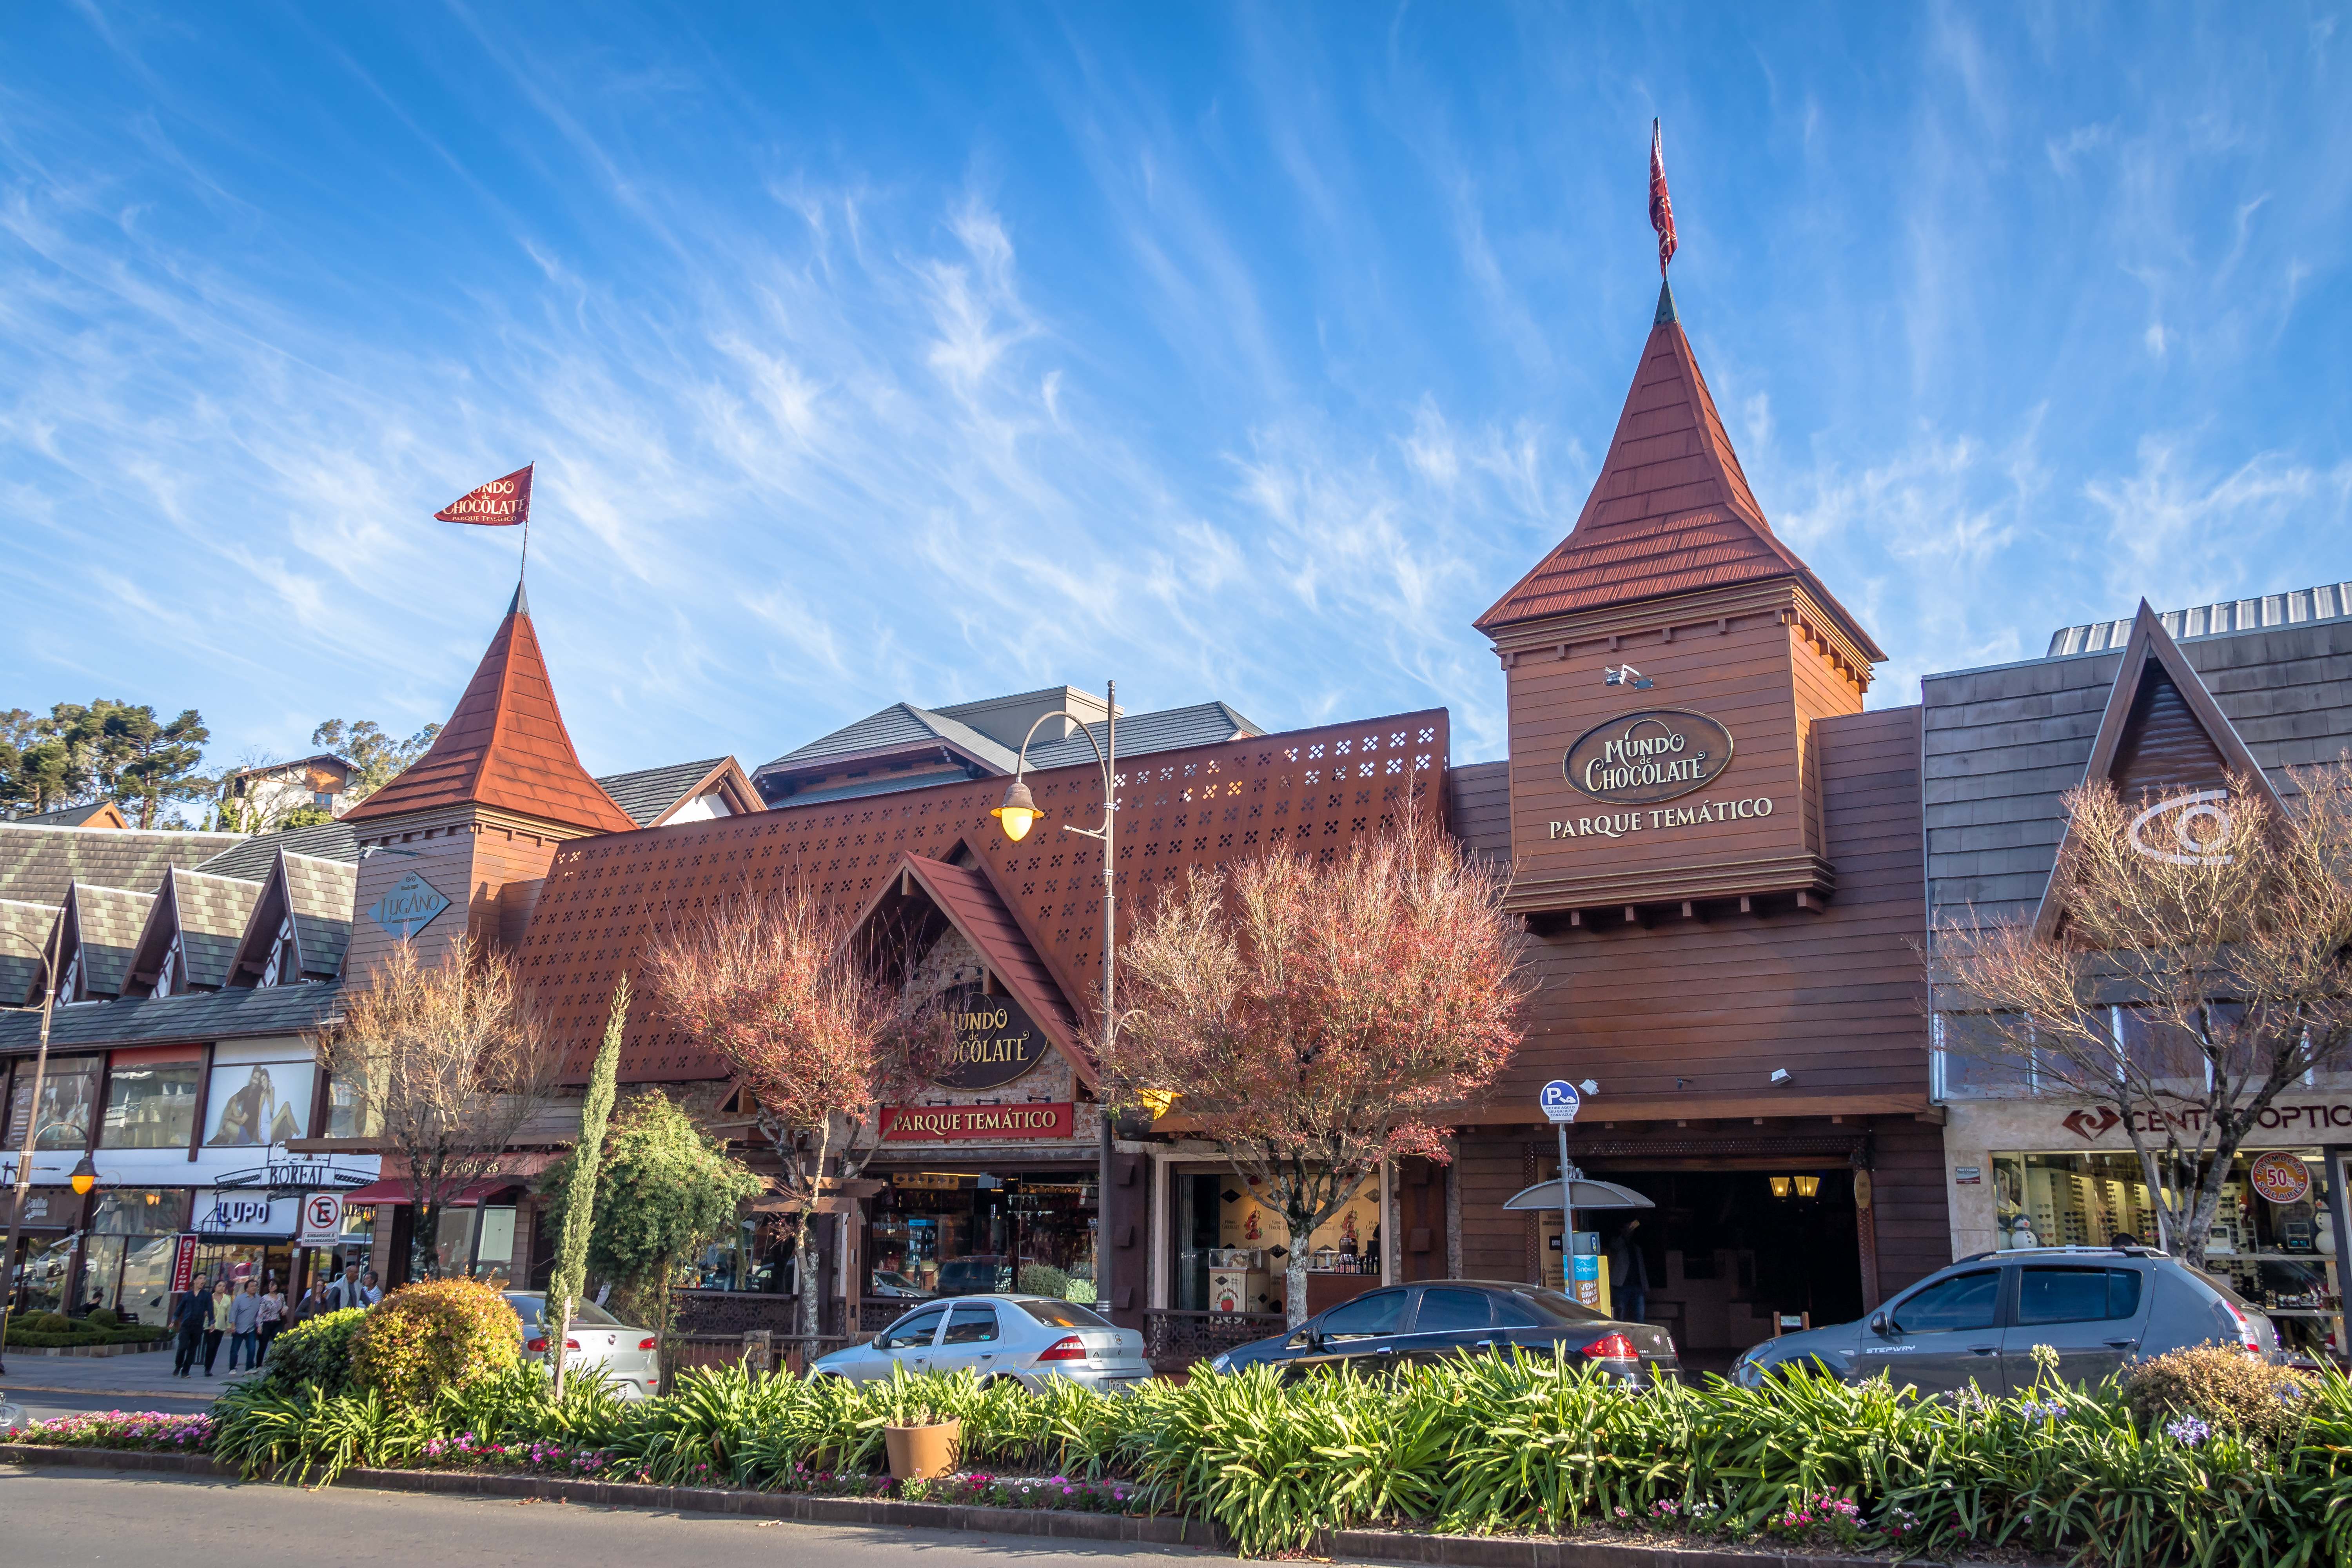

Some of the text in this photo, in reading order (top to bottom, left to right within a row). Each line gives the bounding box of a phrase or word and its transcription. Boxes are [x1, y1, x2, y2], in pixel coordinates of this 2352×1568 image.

[472, 481, 514, 494] UNDO
[1639, 755, 1652, 765] de
[1585, 751, 1707, 792] CHOCOLATE
[1549, 797, 1773, 838] PARQUE TEMÁTICO
[968, 1031, 979, 1041] de
[1547, 1087, 1561, 1104] P
[893, 1107, 1056, 1136] PARQUE TEMÁTICO
[269, 1166, 322, 1185] BOREAL
[2267, 1168, 2295, 1186] 50%
[2257, 1181, 2305, 1200] SOLARES
[217, 1201, 270, 1225] LUPO
[1866, 1345, 1915, 1354] STEPWAY
